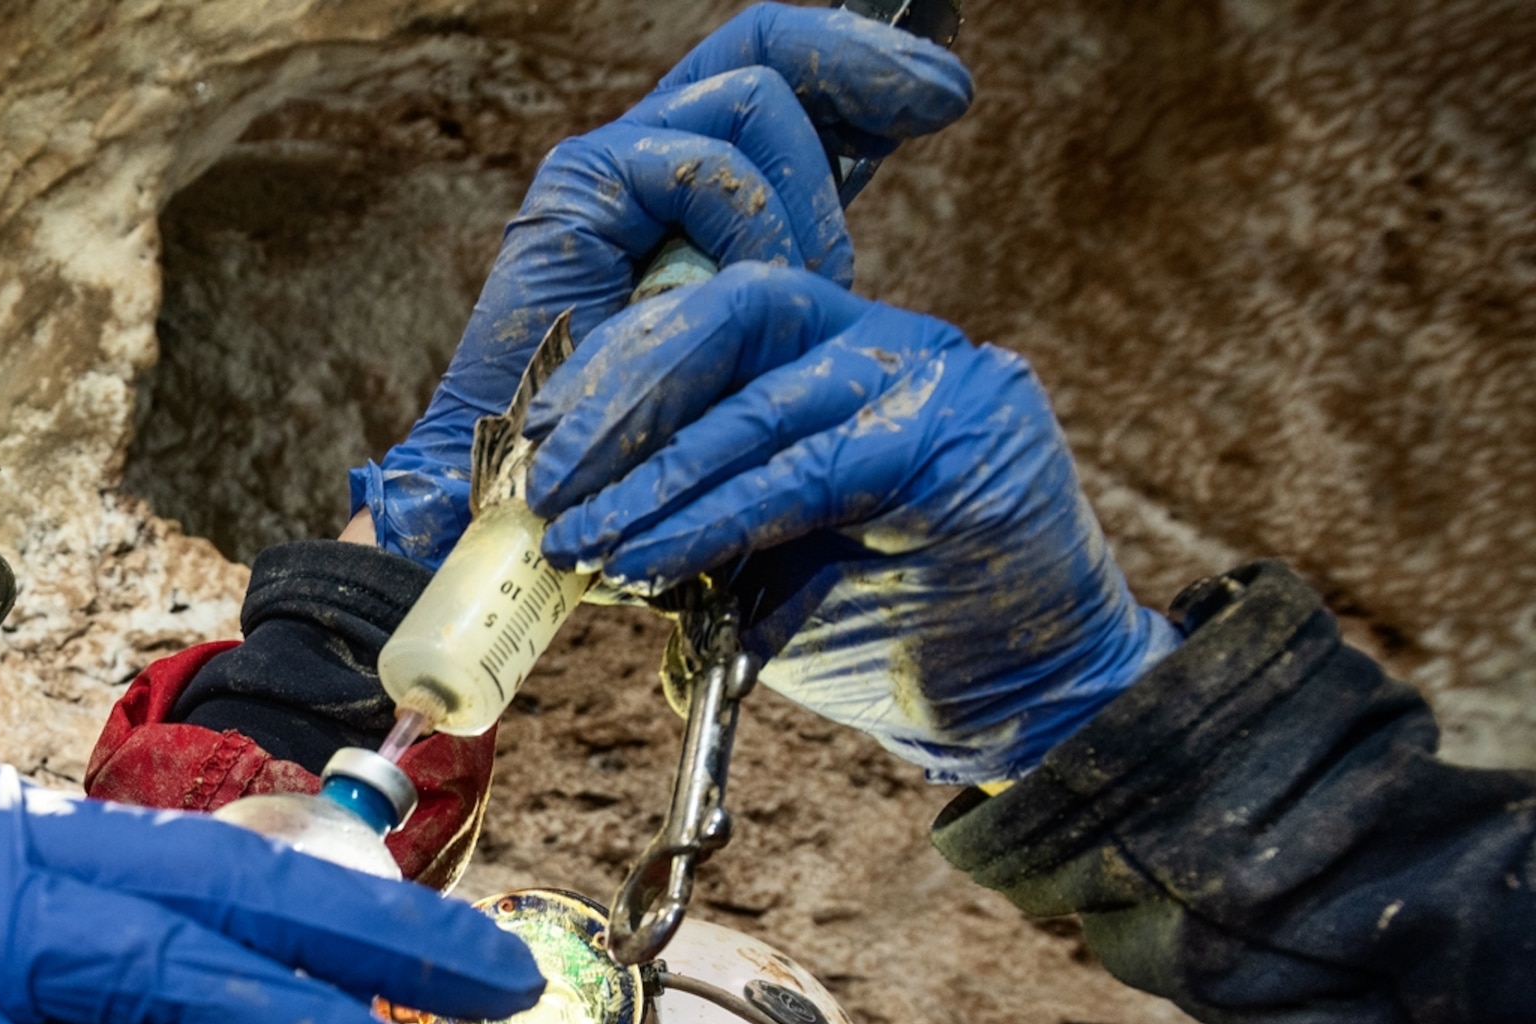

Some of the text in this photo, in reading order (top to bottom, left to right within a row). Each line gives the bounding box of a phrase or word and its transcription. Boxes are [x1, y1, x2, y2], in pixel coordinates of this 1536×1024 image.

[522, 550, 543, 570] 15
[500, 580, 522, 601] 10
[484, 612, 498, 628] 5
